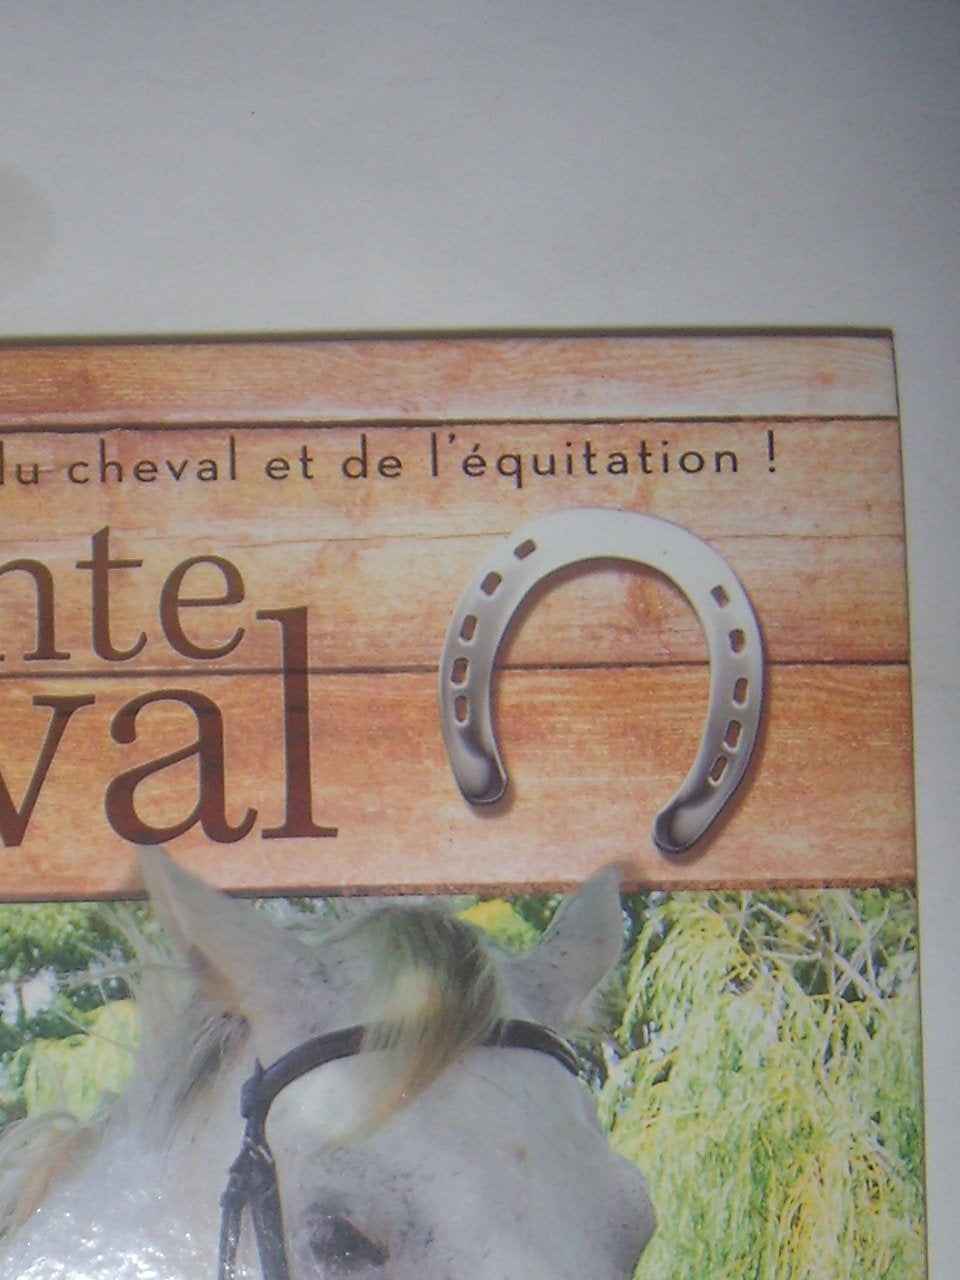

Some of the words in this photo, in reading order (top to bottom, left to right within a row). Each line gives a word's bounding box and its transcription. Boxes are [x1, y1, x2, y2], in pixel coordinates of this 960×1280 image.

[67, 437, 239, 485] cheval
[264, 445, 316, 482] et
[341, 433, 404, 480] de
[766, 429, 780, 473] !
